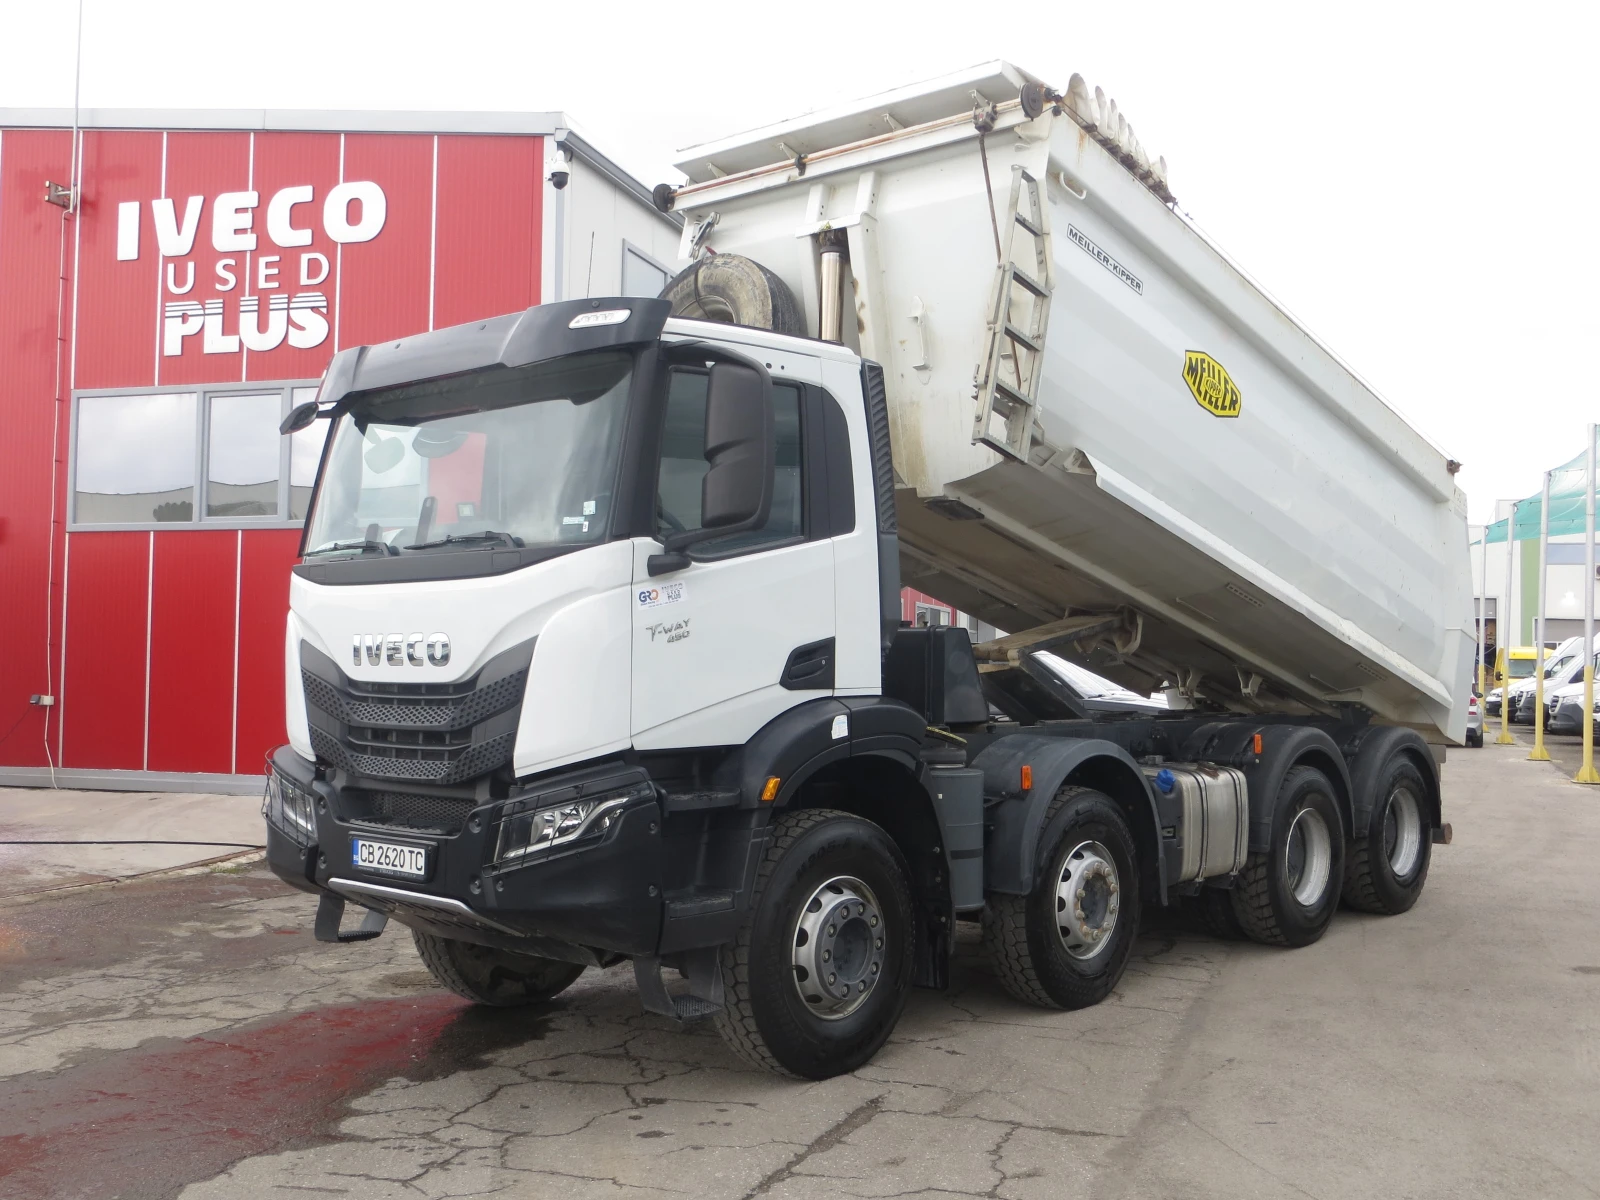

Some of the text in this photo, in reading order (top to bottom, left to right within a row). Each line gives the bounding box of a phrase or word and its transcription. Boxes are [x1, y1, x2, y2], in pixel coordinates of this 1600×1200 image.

[117, 181, 387, 261] IVECO
[166, 252, 330, 294] USED
[1068, 227, 1142, 292] MEILLER-KIPPER
[164, 292, 329, 357] PLUS
[1186, 356, 1239, 412] MEILLER
[352, 631, 452, 668] IVECO
[645, 618, 691, 642] T-WAY
[360, 843, 424, 872] CB 2620 TC
